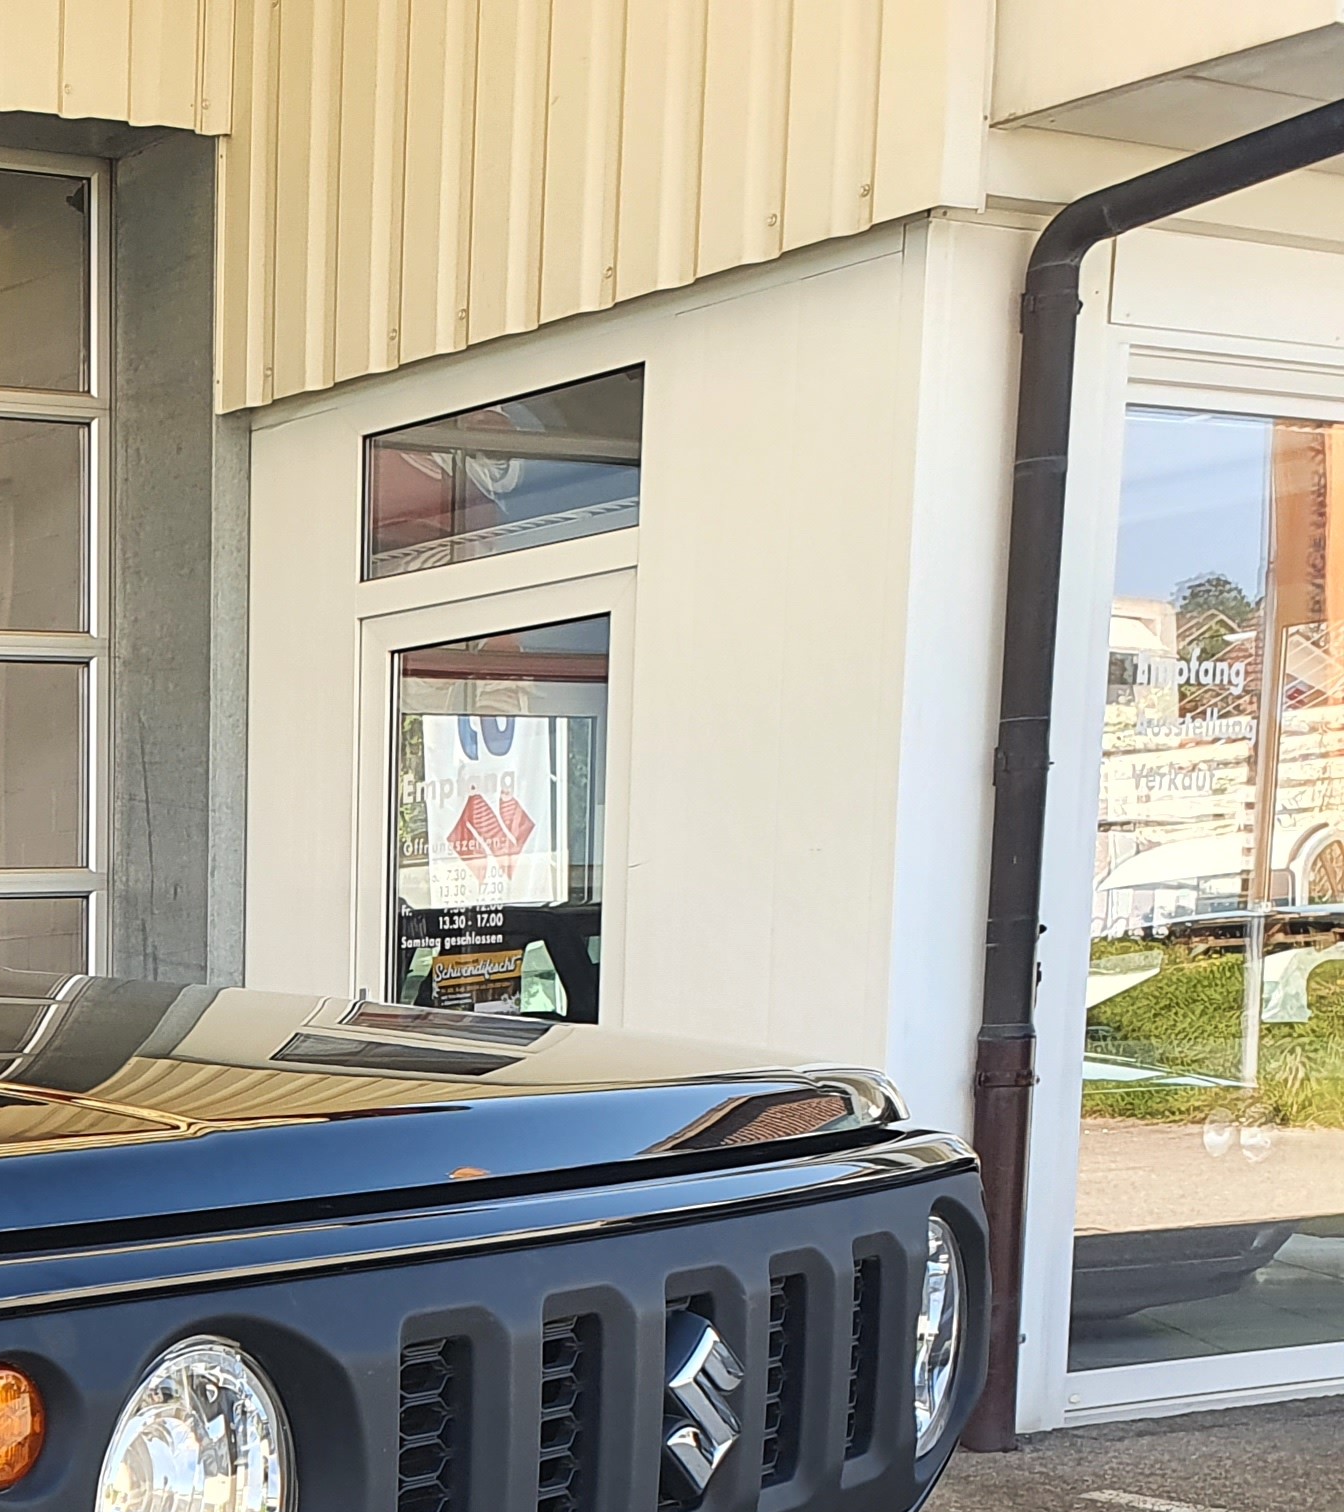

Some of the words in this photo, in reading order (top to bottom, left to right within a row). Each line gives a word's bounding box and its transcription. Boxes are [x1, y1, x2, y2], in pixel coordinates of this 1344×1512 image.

[401, 765, 516, 810] Empfang
[402, 835, 507, 857] Öffnungszeien:
[438, 916, 467, 930] 13.30
[476, 913, 504, 928] 17.00
[401, 936, 442, 950] Samstag
[444, 933, 504, 950] geschlossen
